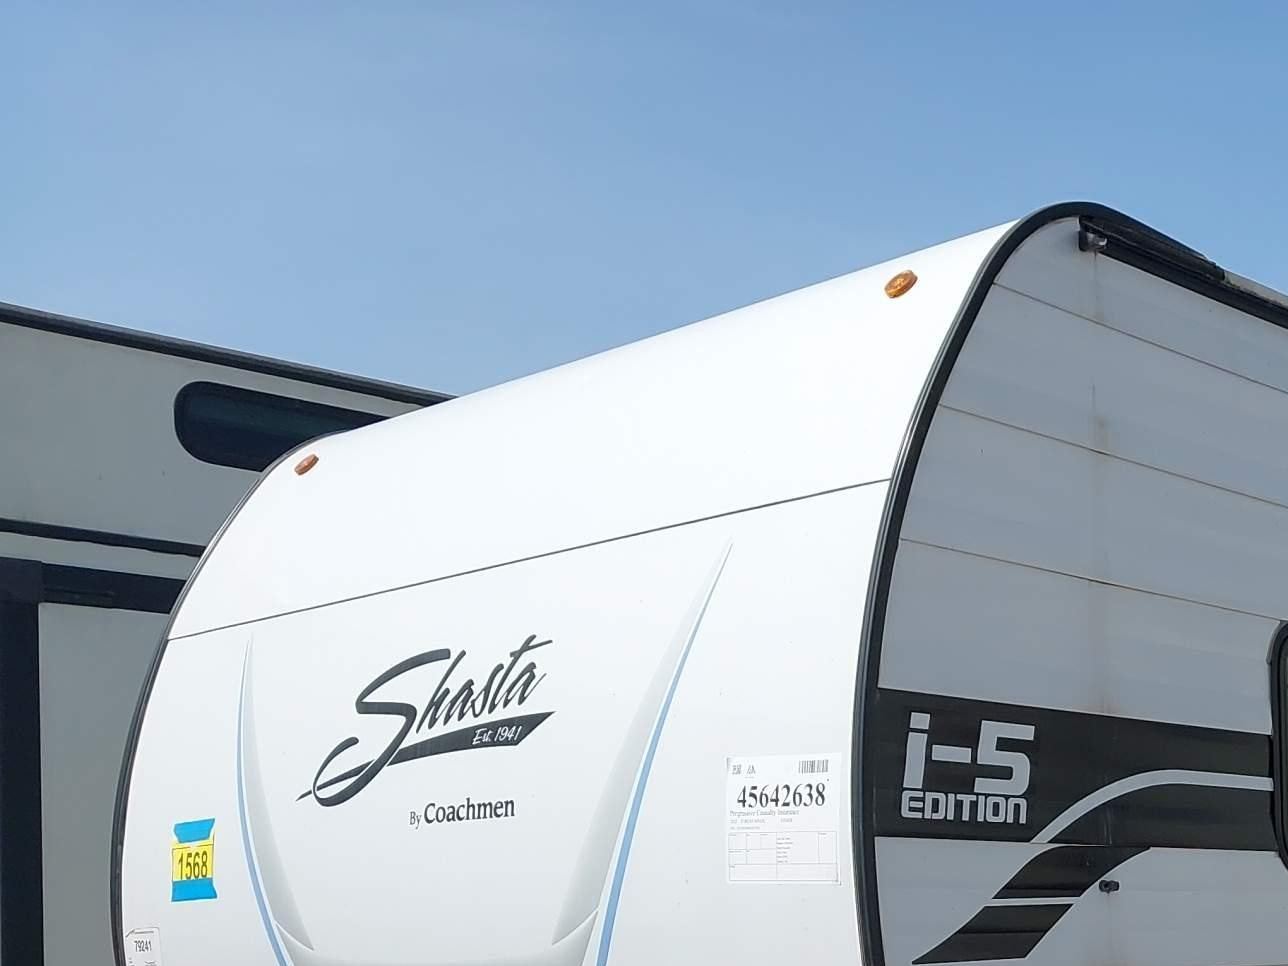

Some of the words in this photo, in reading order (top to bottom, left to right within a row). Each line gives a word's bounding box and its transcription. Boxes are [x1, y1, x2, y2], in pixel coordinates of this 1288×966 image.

[313, 633, 553, 808] Shasta
[494, 725, 522, 743] 1941
[736, 782, 826, 809] 45642638
[901, 791, 1028, 825] EDITION
[409, 811, 422, 830] By
[423, 797, 515, 825] Coachmen
[177, 851, 208, 881] 1568
[134, 940, 152, 952] 79241
